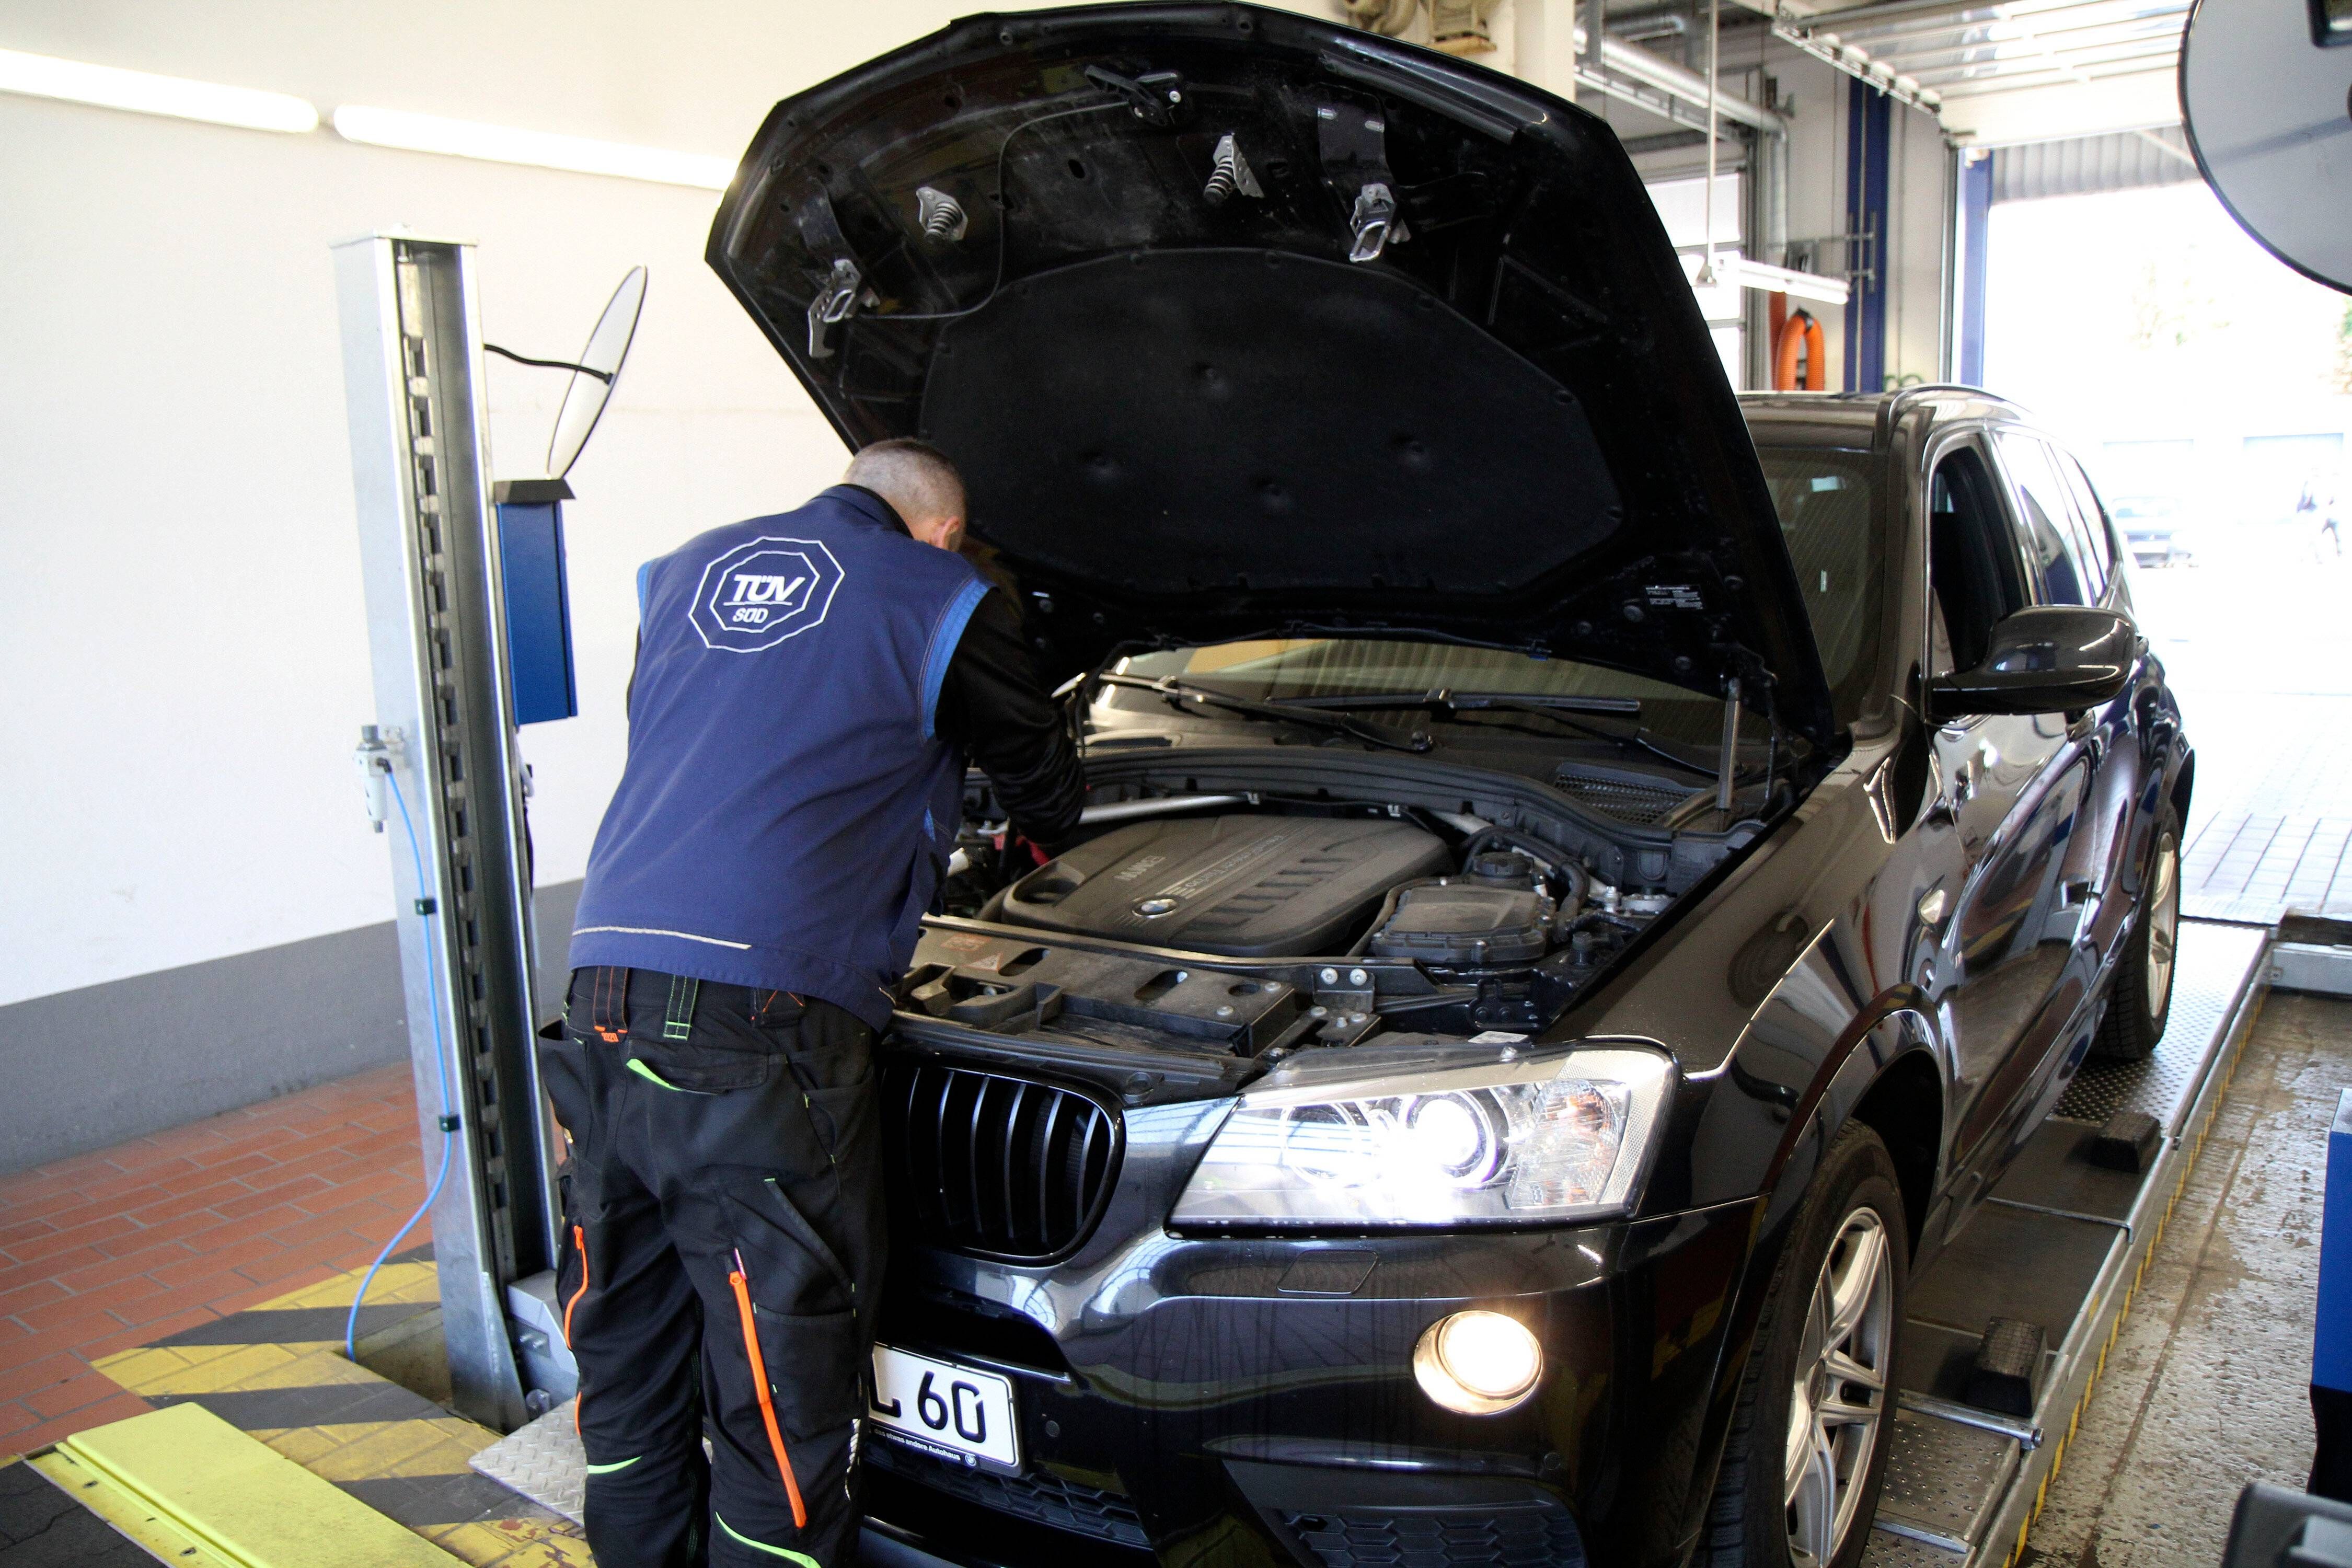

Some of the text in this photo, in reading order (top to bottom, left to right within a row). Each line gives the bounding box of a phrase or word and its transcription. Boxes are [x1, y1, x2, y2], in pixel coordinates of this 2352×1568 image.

[733, 574, 806, 603] TÜV
[732, 607, 769, 624] SÜD
[918, 1370, 986, 1443] 60
[874, 1428, 961, 1461] das etwas andere Autohaus
